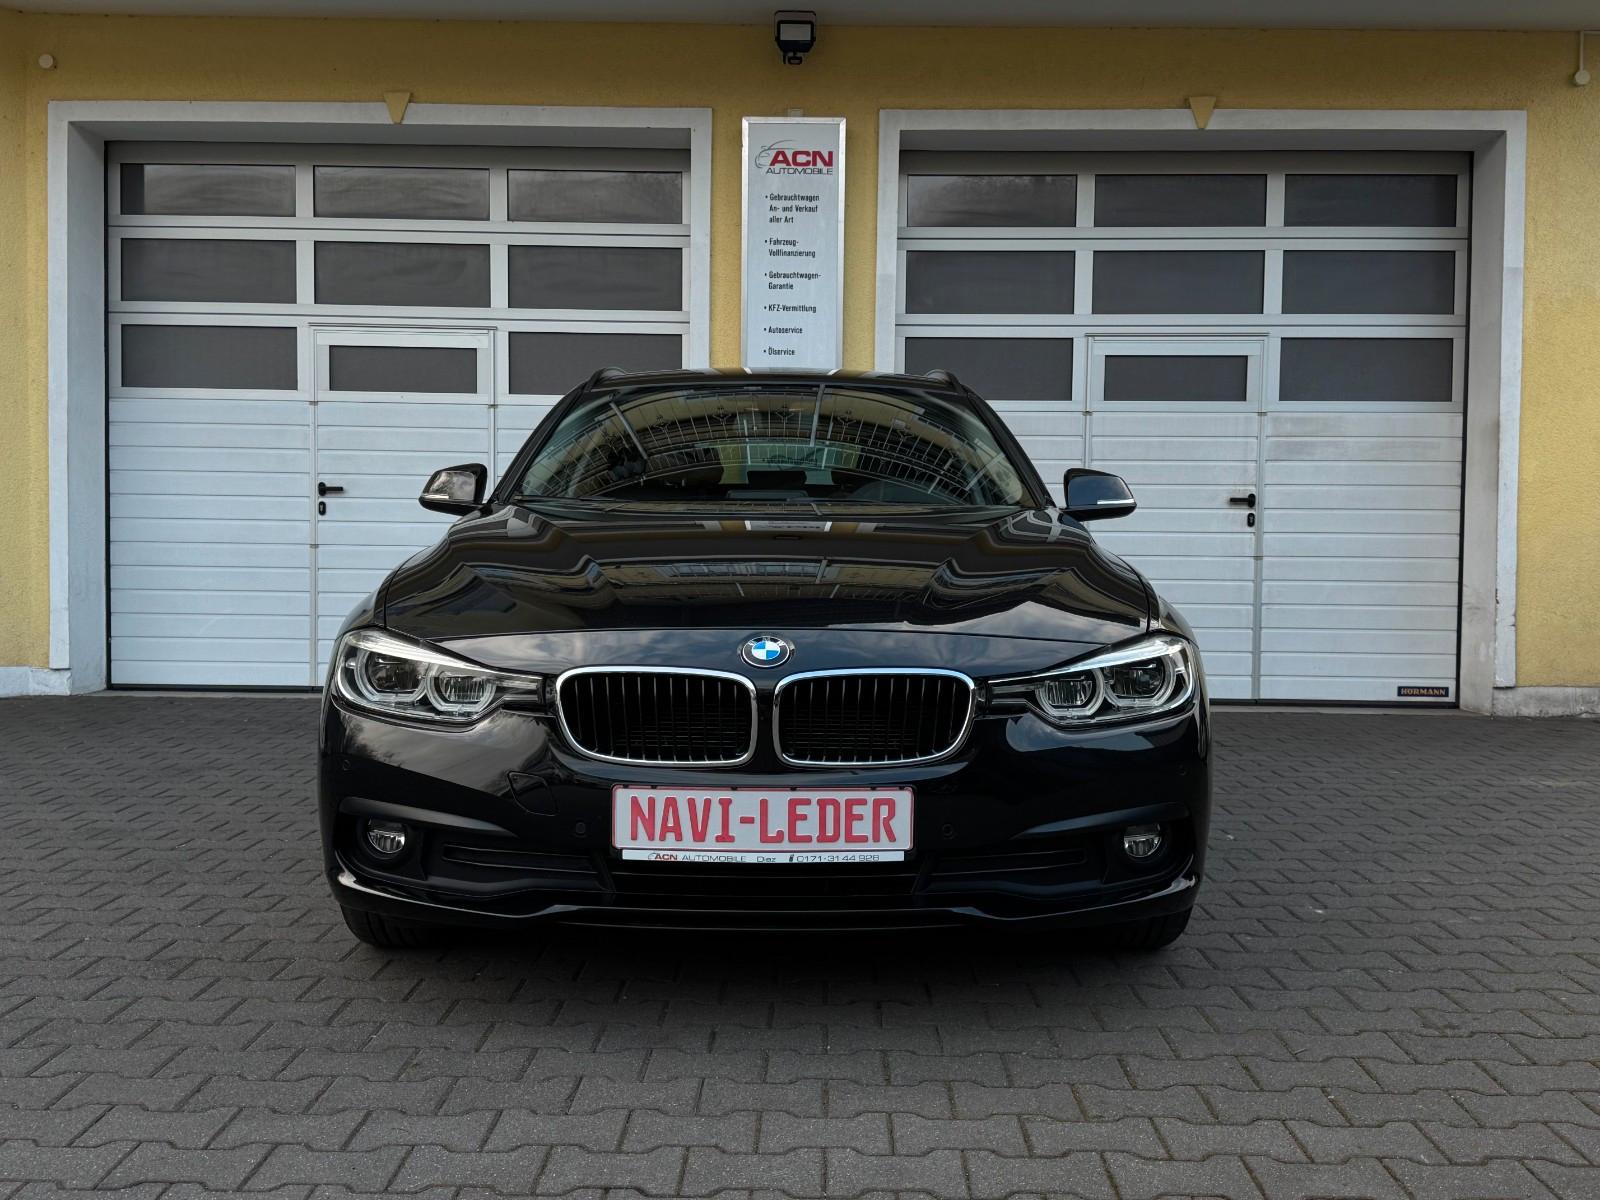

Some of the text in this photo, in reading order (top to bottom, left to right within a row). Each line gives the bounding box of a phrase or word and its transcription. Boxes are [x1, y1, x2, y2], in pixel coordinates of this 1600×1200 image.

[769, 150, 834, 167] ACN
[766, 167, 834, 175] AUTOMOBILE
[769, 193, 820, 203] Gebrauchtwagen
[769, 204, 819, 213] An- und Verkauf
[769, 215, 794, 224] aller Art
[769, 238, 799, 247] Fahrzeug-
[768, 248, 816, 258] Vollfinanzierung
[768, 271, 822, 281] Gebrauchtwagen-
[768, 282, 794, 290] Garantie
[768, 304, 817, 313] KFZ-Vermittlung
[768, 326, 803, 334] Autoservice
[768, 346, 796, 355] Ölservice
[630, 795, 897, 844] NAVI-LEDER
[655, 853, 678, 861] ACN
[682, 854, 746, 863] AUTOMOBILE
